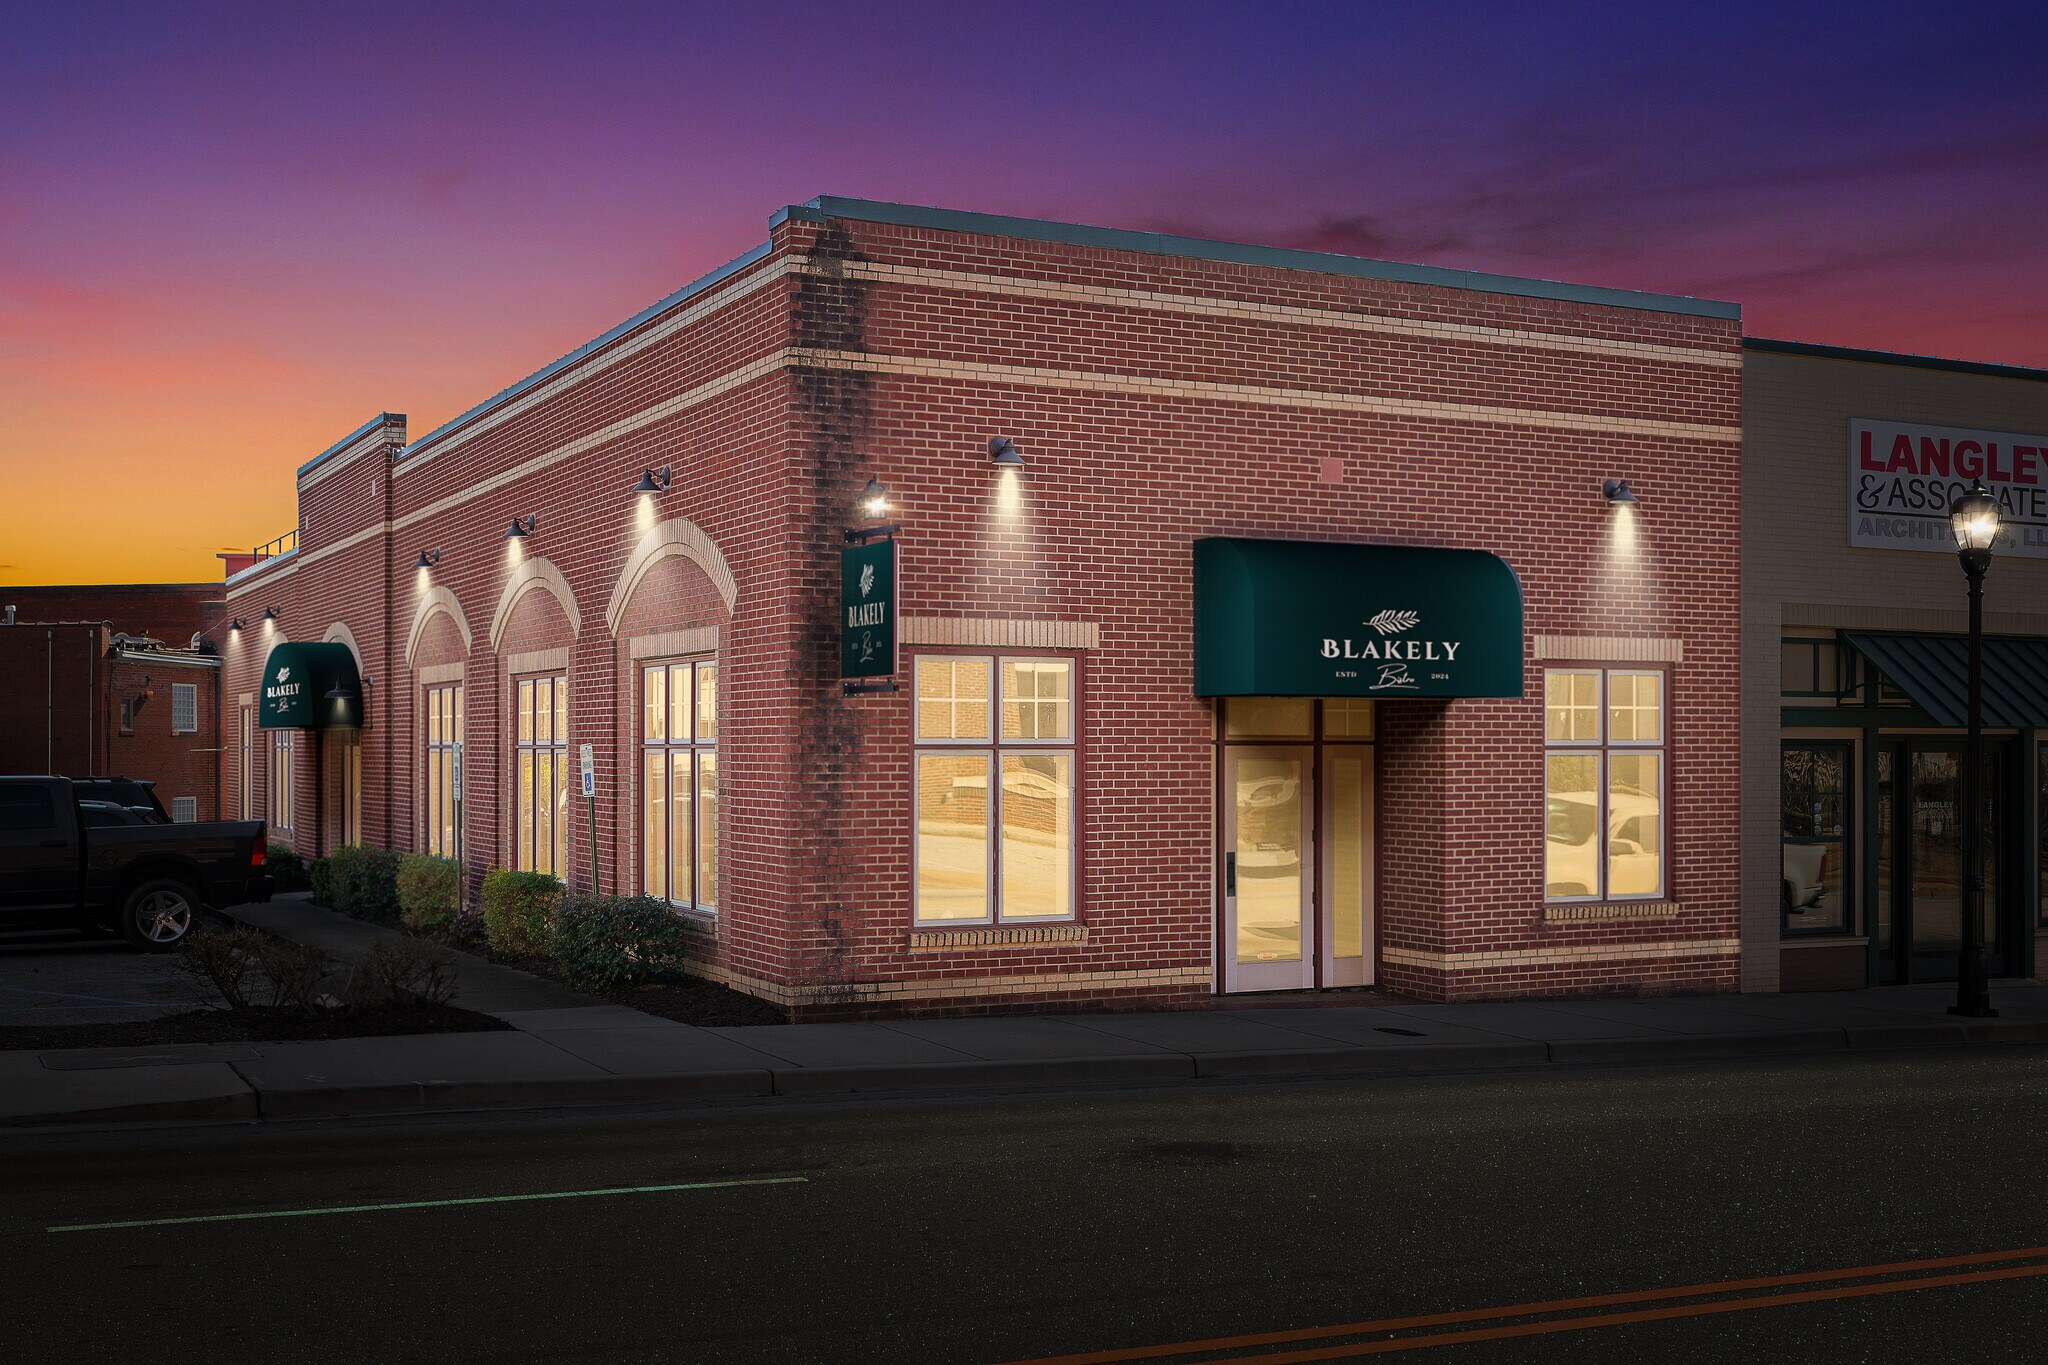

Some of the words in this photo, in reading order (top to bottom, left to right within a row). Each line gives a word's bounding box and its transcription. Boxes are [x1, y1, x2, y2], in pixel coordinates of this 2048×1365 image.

[1856, 474, 1887, 509] &
[1887, 477, 2047, 518] ASSOATE
[1857, 517, 2017, 549] ARCHITS,
[848, 602, 885, 628] BLAKELY
[1320, 638, 1461, 661] BLAKELY
[1369, 663, 1420, 690] Bistro
[267, 683, 300, 698] BLAKELY
